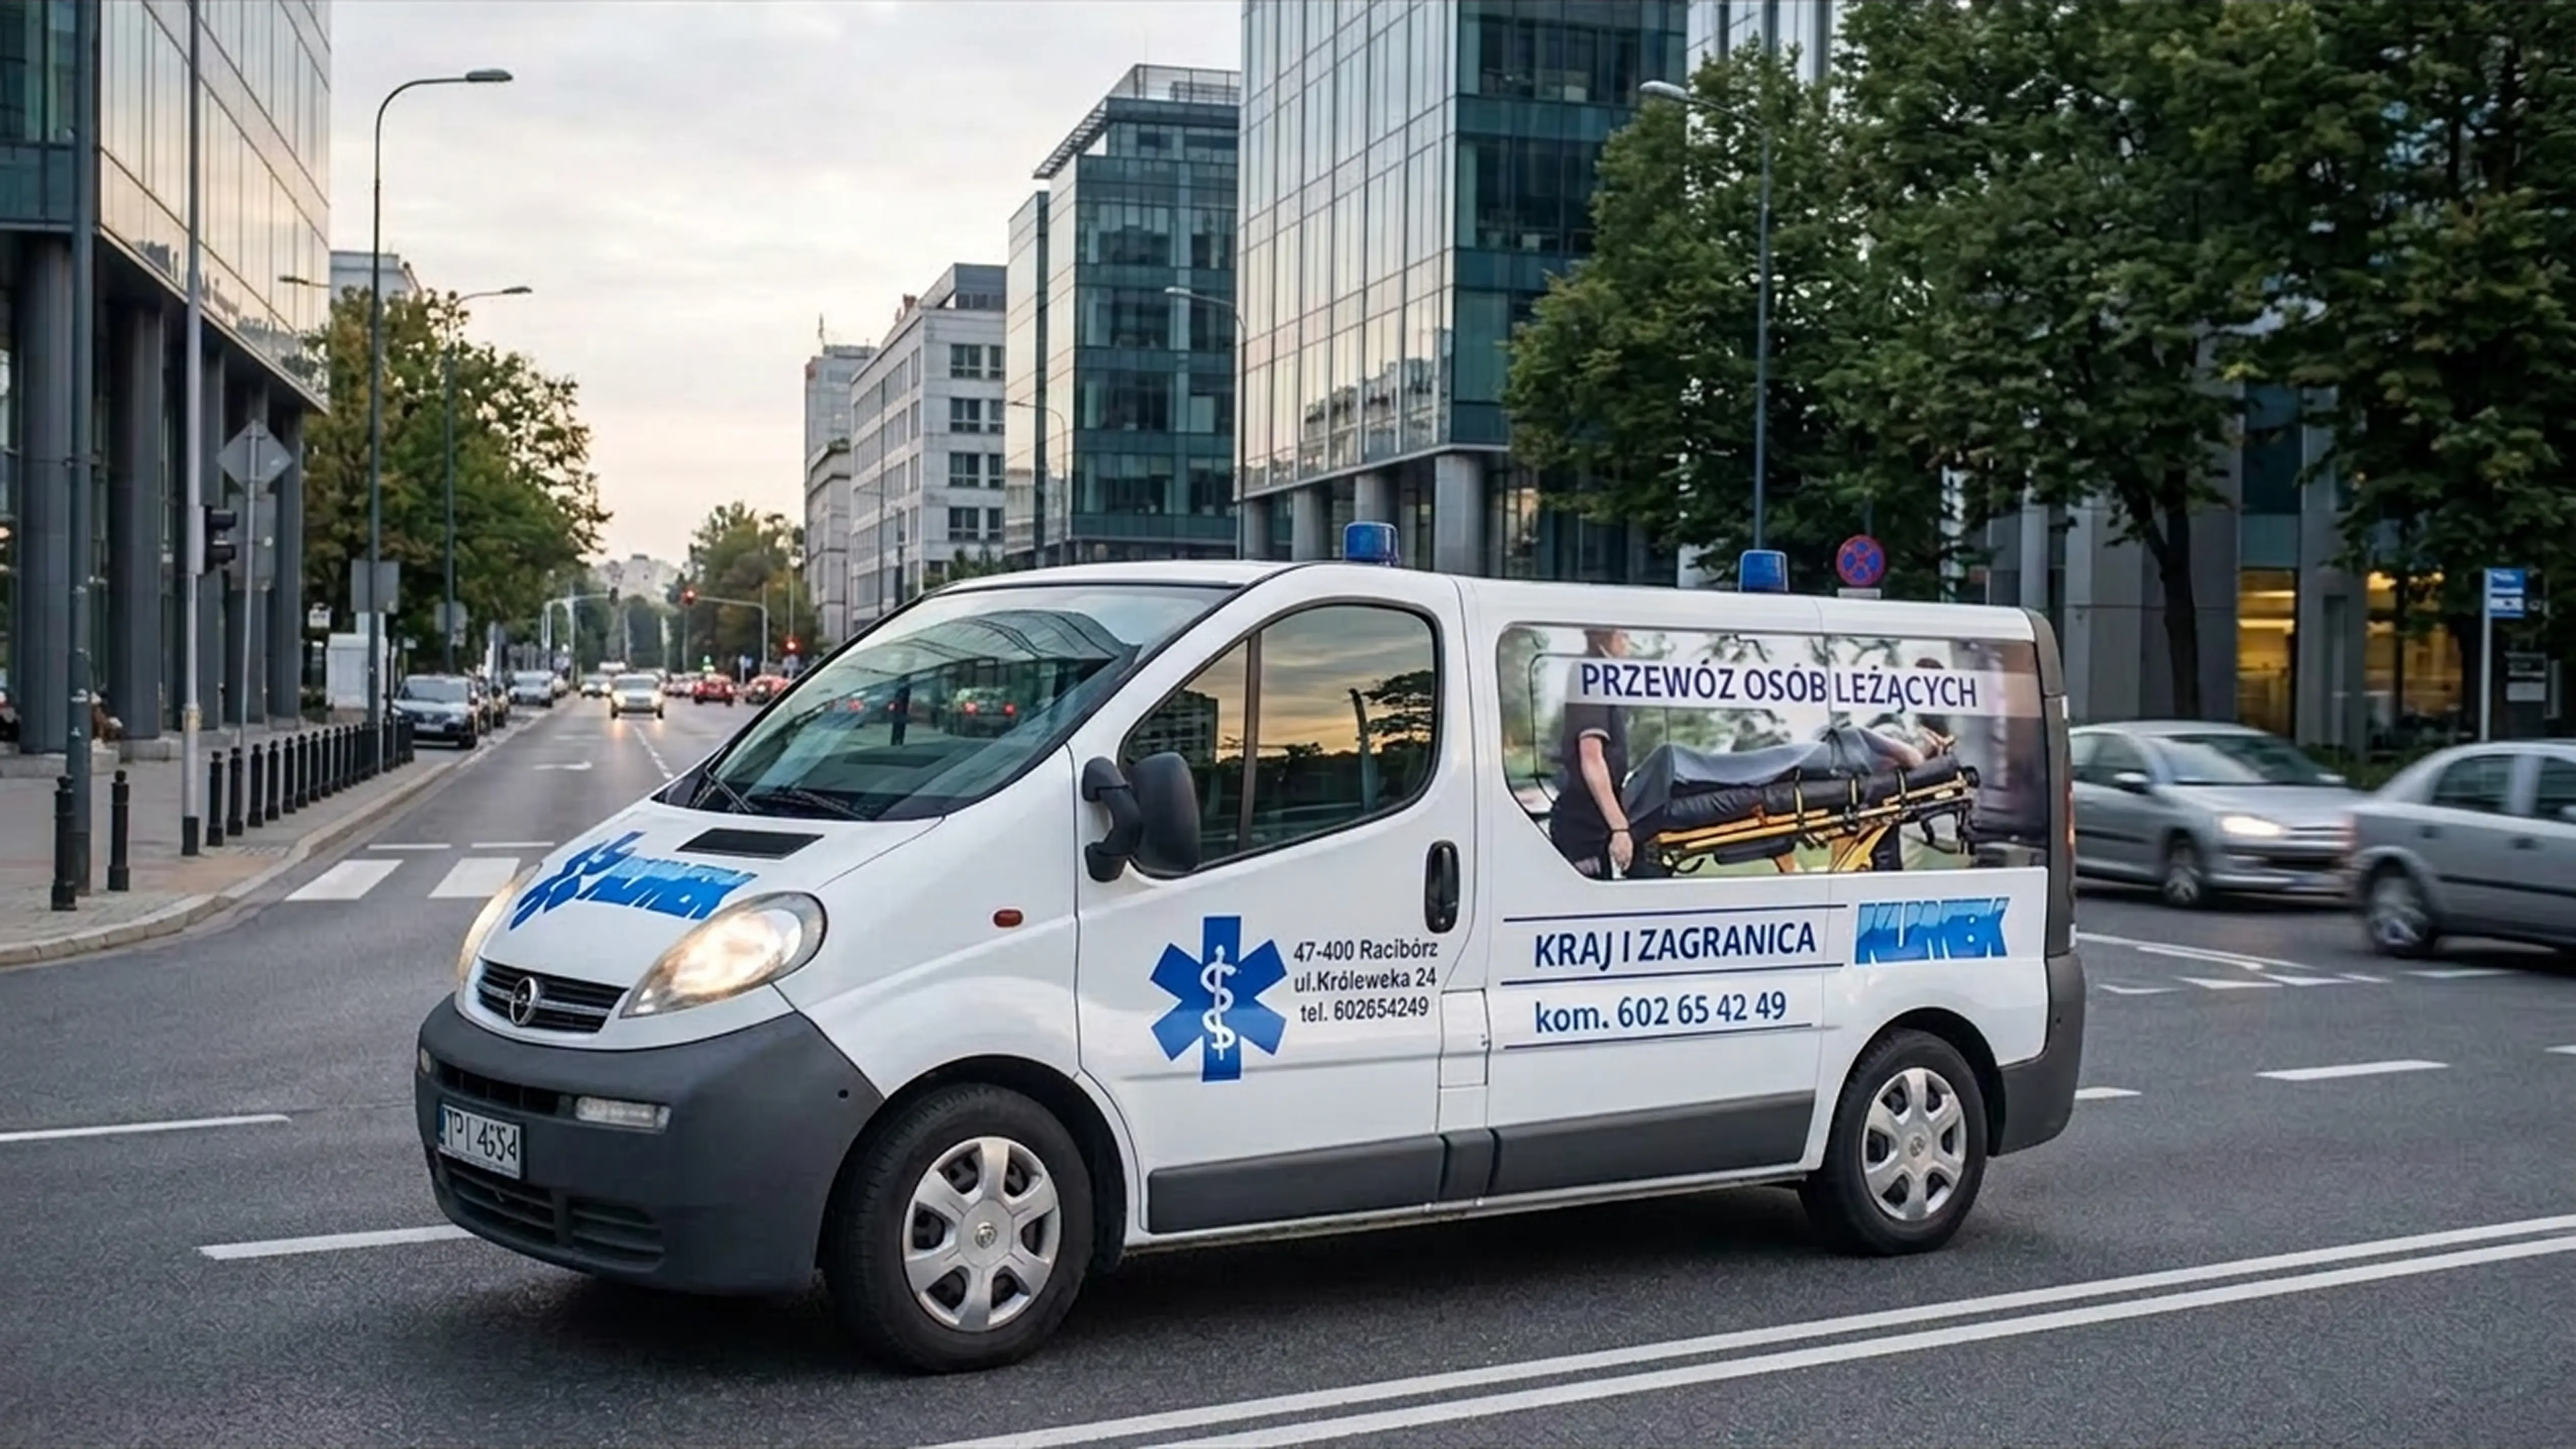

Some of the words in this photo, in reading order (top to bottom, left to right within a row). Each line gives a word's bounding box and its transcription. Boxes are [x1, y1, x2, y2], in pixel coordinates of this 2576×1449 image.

[1581, 658, 1736, 699] PRZEWÓZ
[1744, 663, 1827, 703] OSÓB
[1835, 665, 1977, 714] LEŻĄCYCH
[1293, 940, 1354, 962] 47-400
[1360, 937, 1438, 960] Racibórz
[1535, 932, 1613, 972] KRAJ
[1623, 931, 1630, 963] I
[1637, 921, 1816, 961] ZAGRANICA
[1415, 966, 1437, 987] 24
[1300, 1001, 1328, 1023] tel.
[1334, 996, 1429, 1021] 602654249
[1535, 1001, 1609, 1033] kom.
[1618, 995, 1669, 1028] 602
[1677, 994, 1709, 1025] 65
[1716, 993, 1748, 1022] 42
[1755, 991, 1787, 1020] 49
